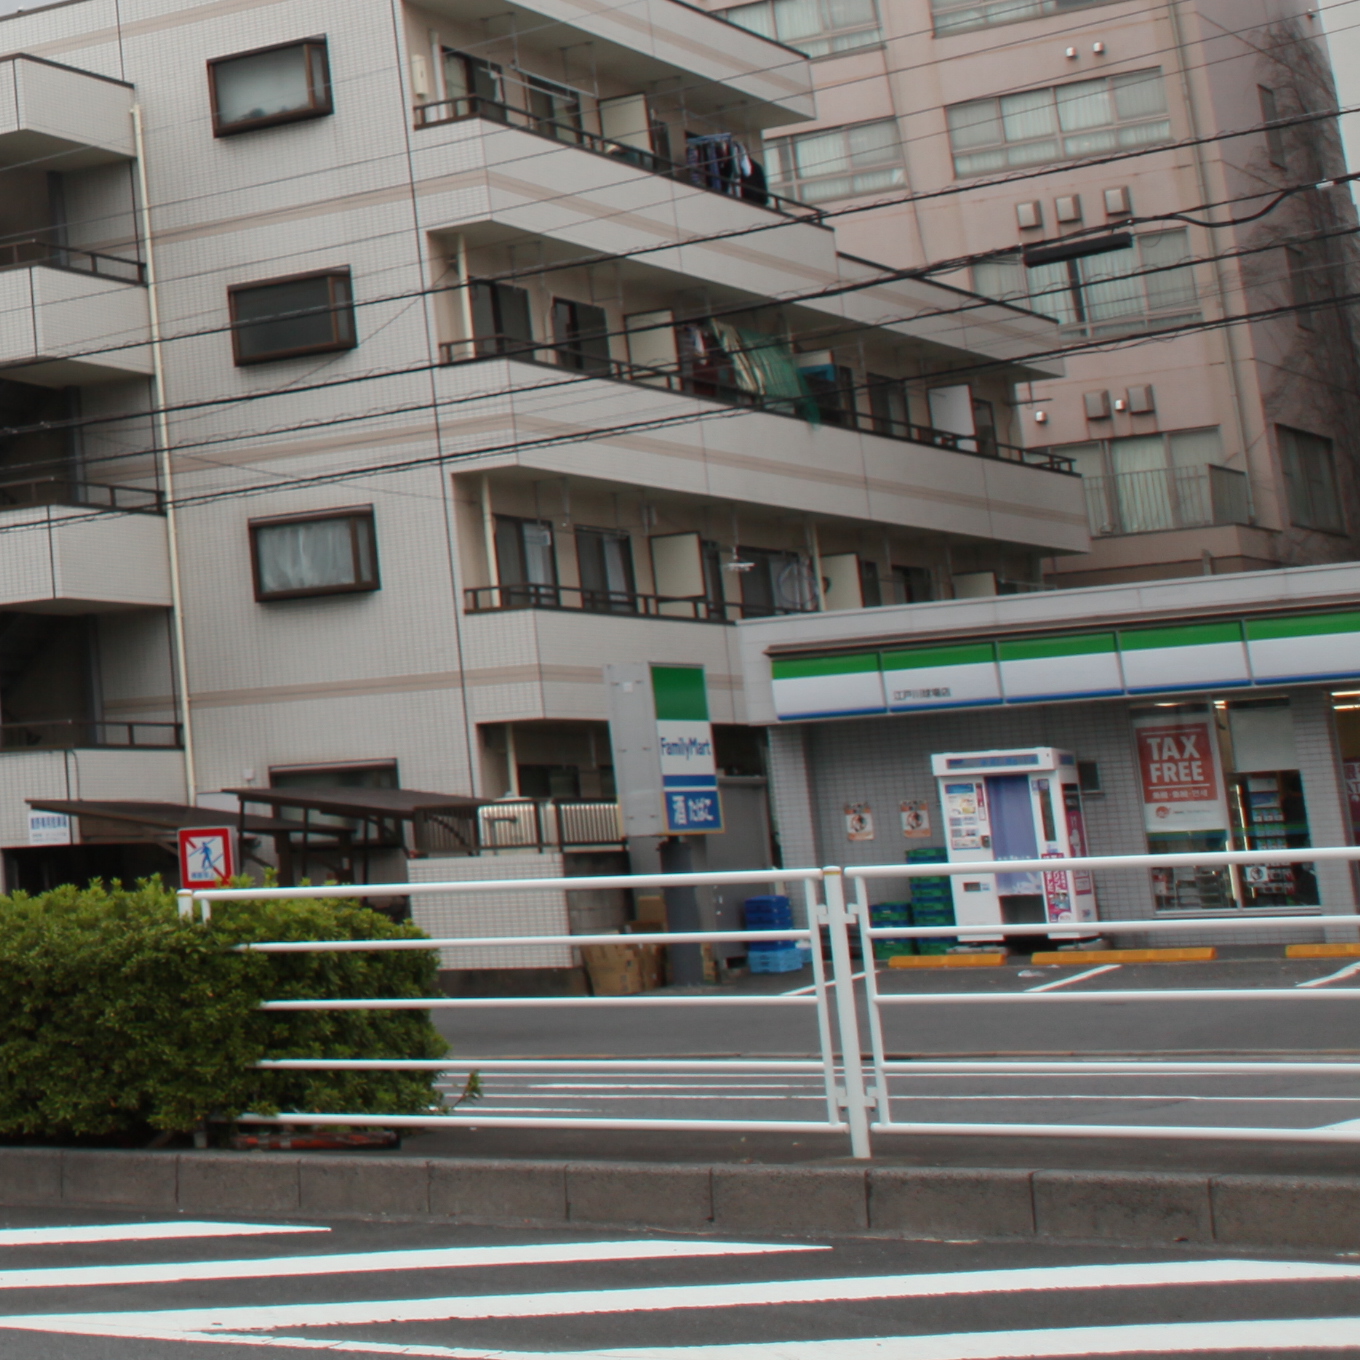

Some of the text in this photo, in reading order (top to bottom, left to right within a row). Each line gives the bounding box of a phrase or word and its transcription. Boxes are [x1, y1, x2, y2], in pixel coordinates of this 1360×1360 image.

[660, 737, 711, 760] FamilyMart
[1146, 735, 1200, 760] TAX
[1149, 761, 1204, 783] FREE
